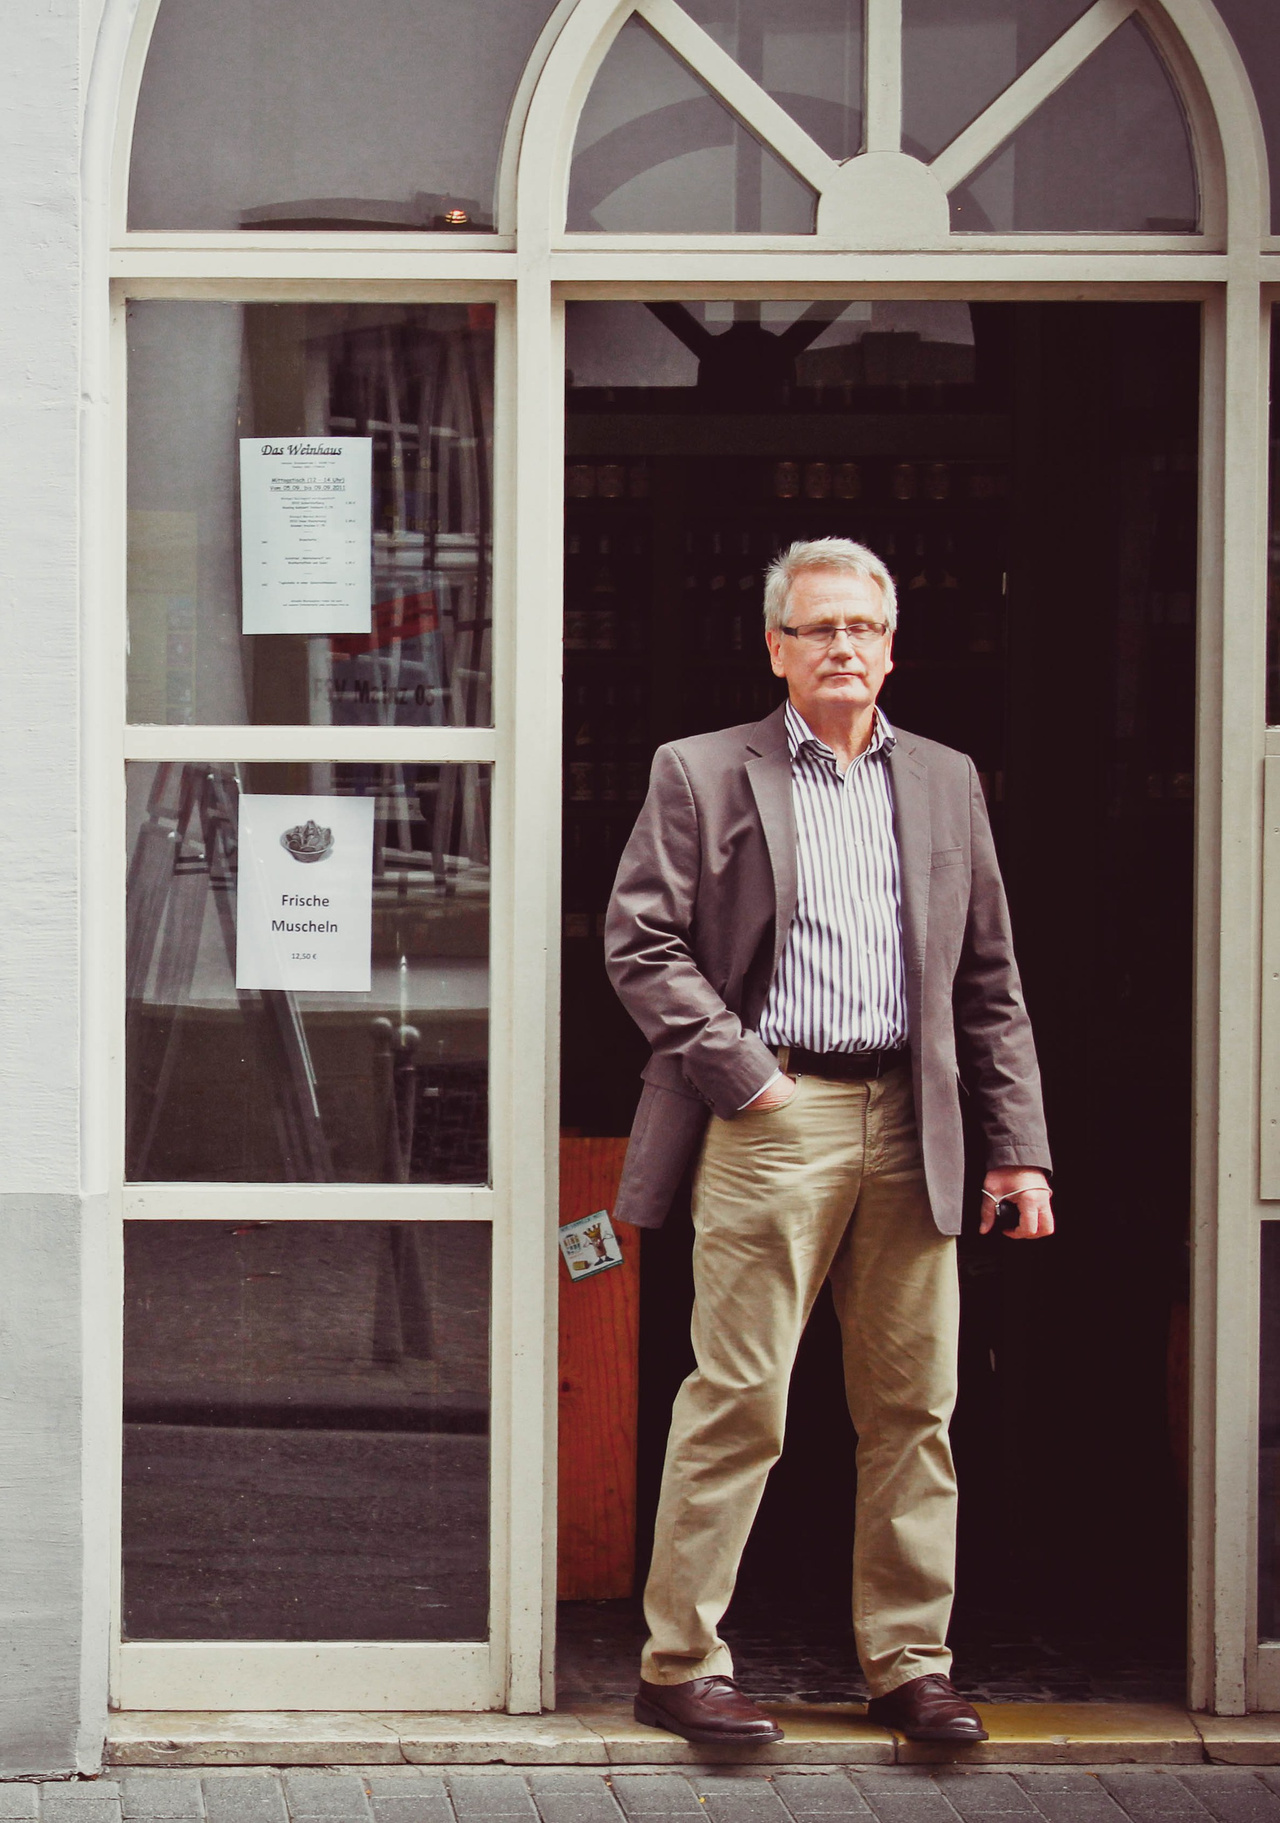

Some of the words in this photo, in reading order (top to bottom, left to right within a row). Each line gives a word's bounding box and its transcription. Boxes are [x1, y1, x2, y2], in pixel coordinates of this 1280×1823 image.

[261, 444, 284, 456] Das
[286, 443, 343, 456] Weinhaus
[281, 894, 330, 907] Frische
[271, 919, 338, 933] Muscheln
[291, 952, 311, 961] 12,50
